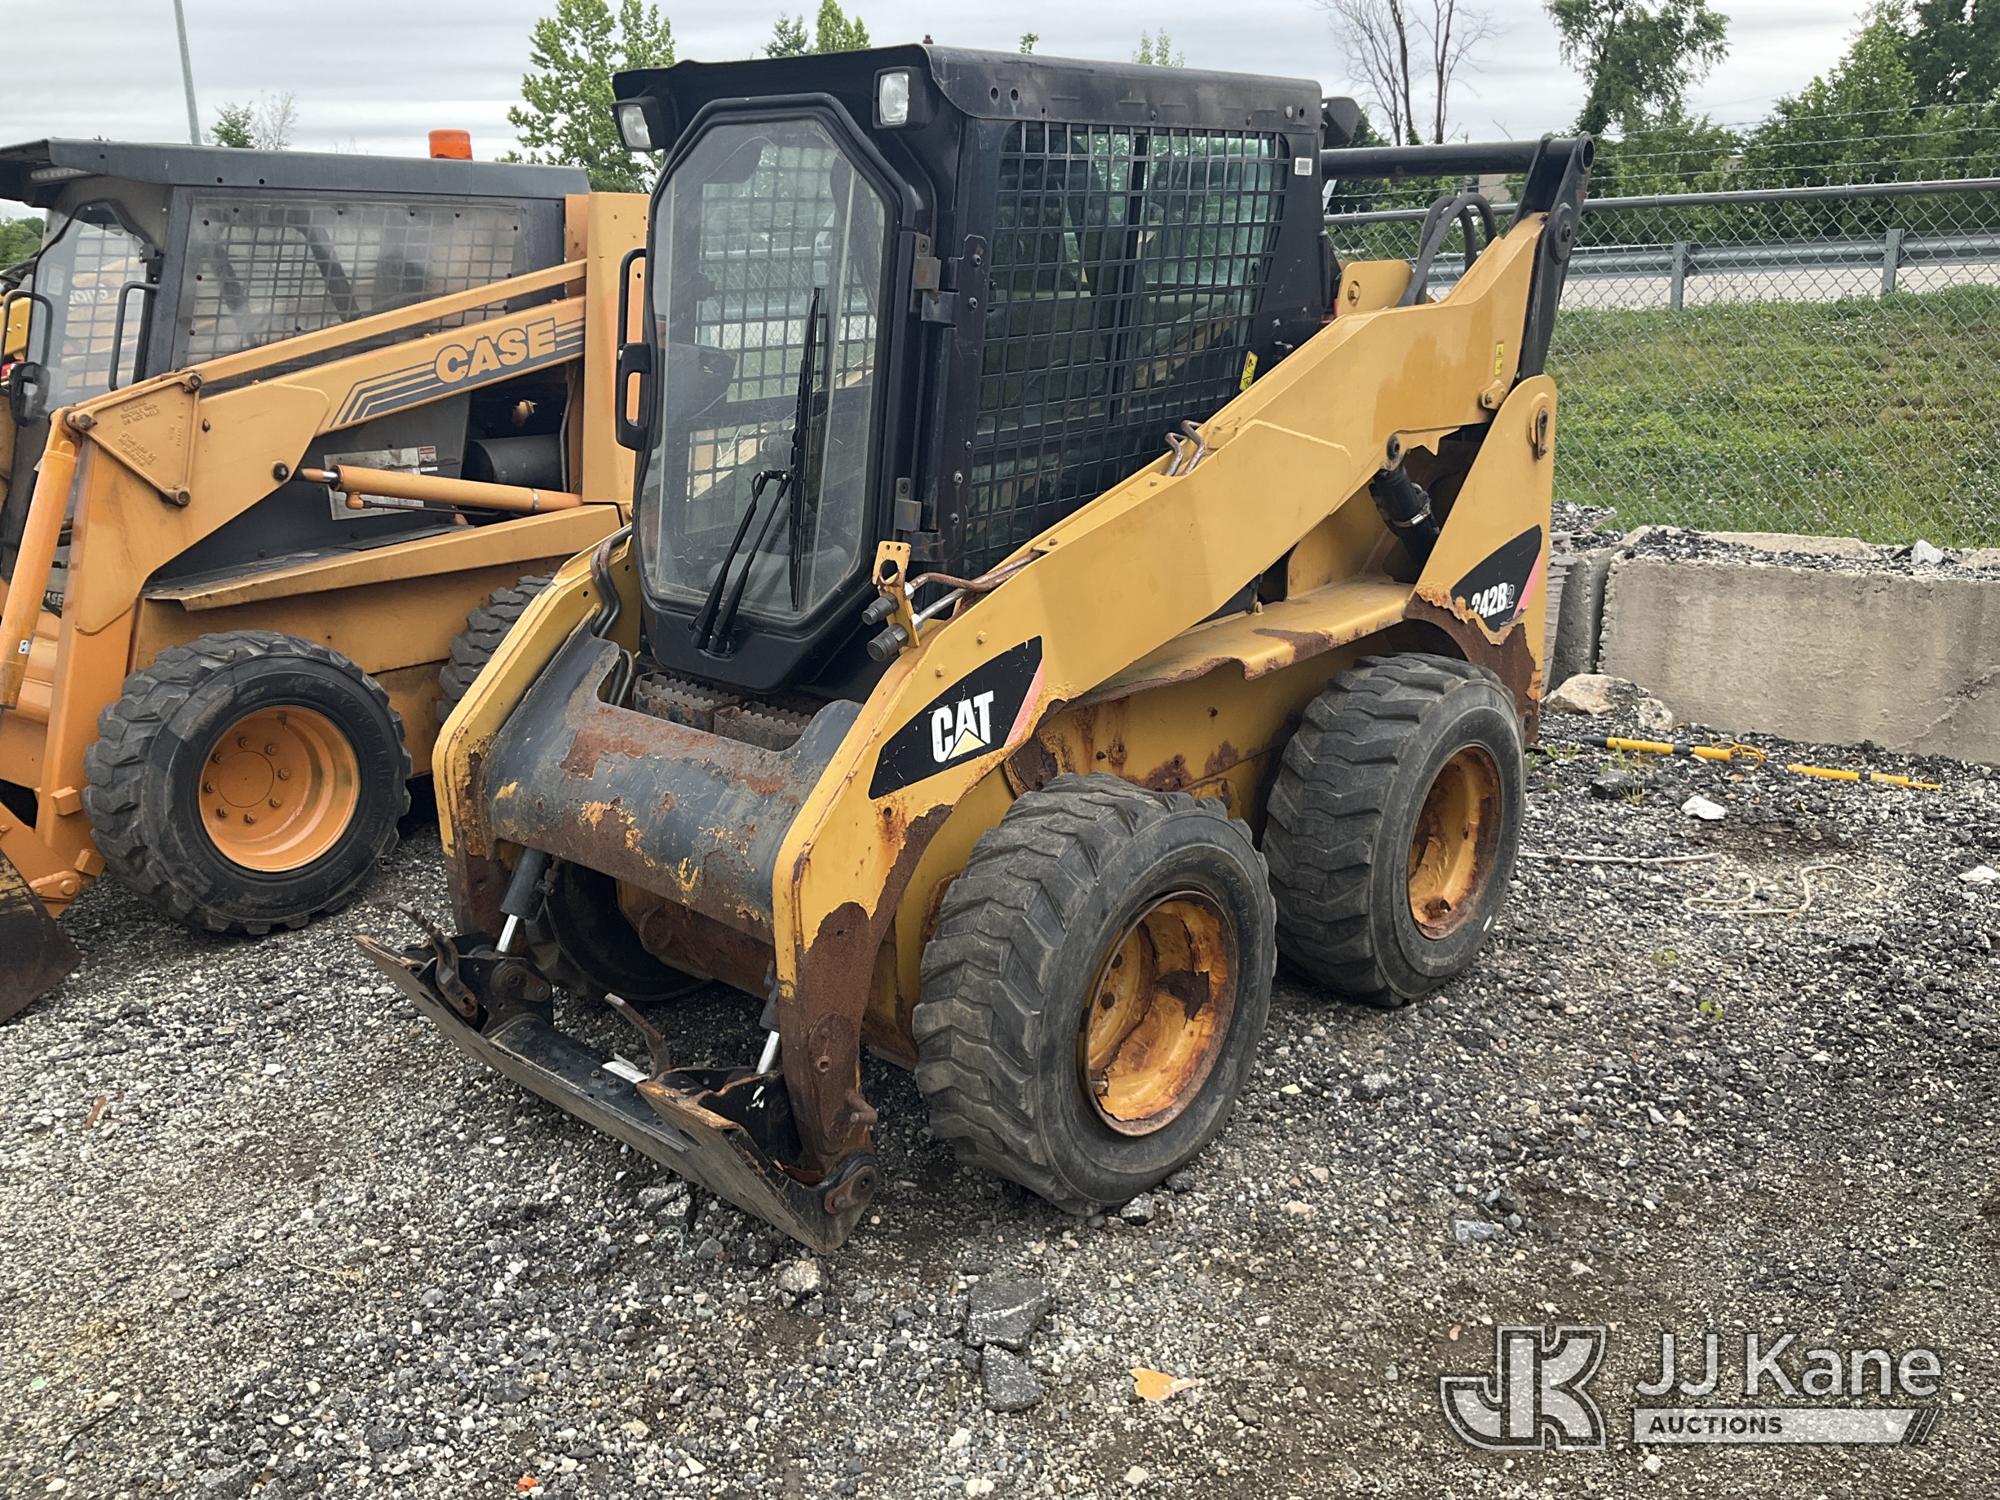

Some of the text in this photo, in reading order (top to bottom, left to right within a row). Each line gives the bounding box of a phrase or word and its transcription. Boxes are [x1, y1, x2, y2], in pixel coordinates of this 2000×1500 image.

[435, 317, 557, 384] CASE
[44, 591, 65, 607] ASE
[931, 690, 994, 763] CAT
